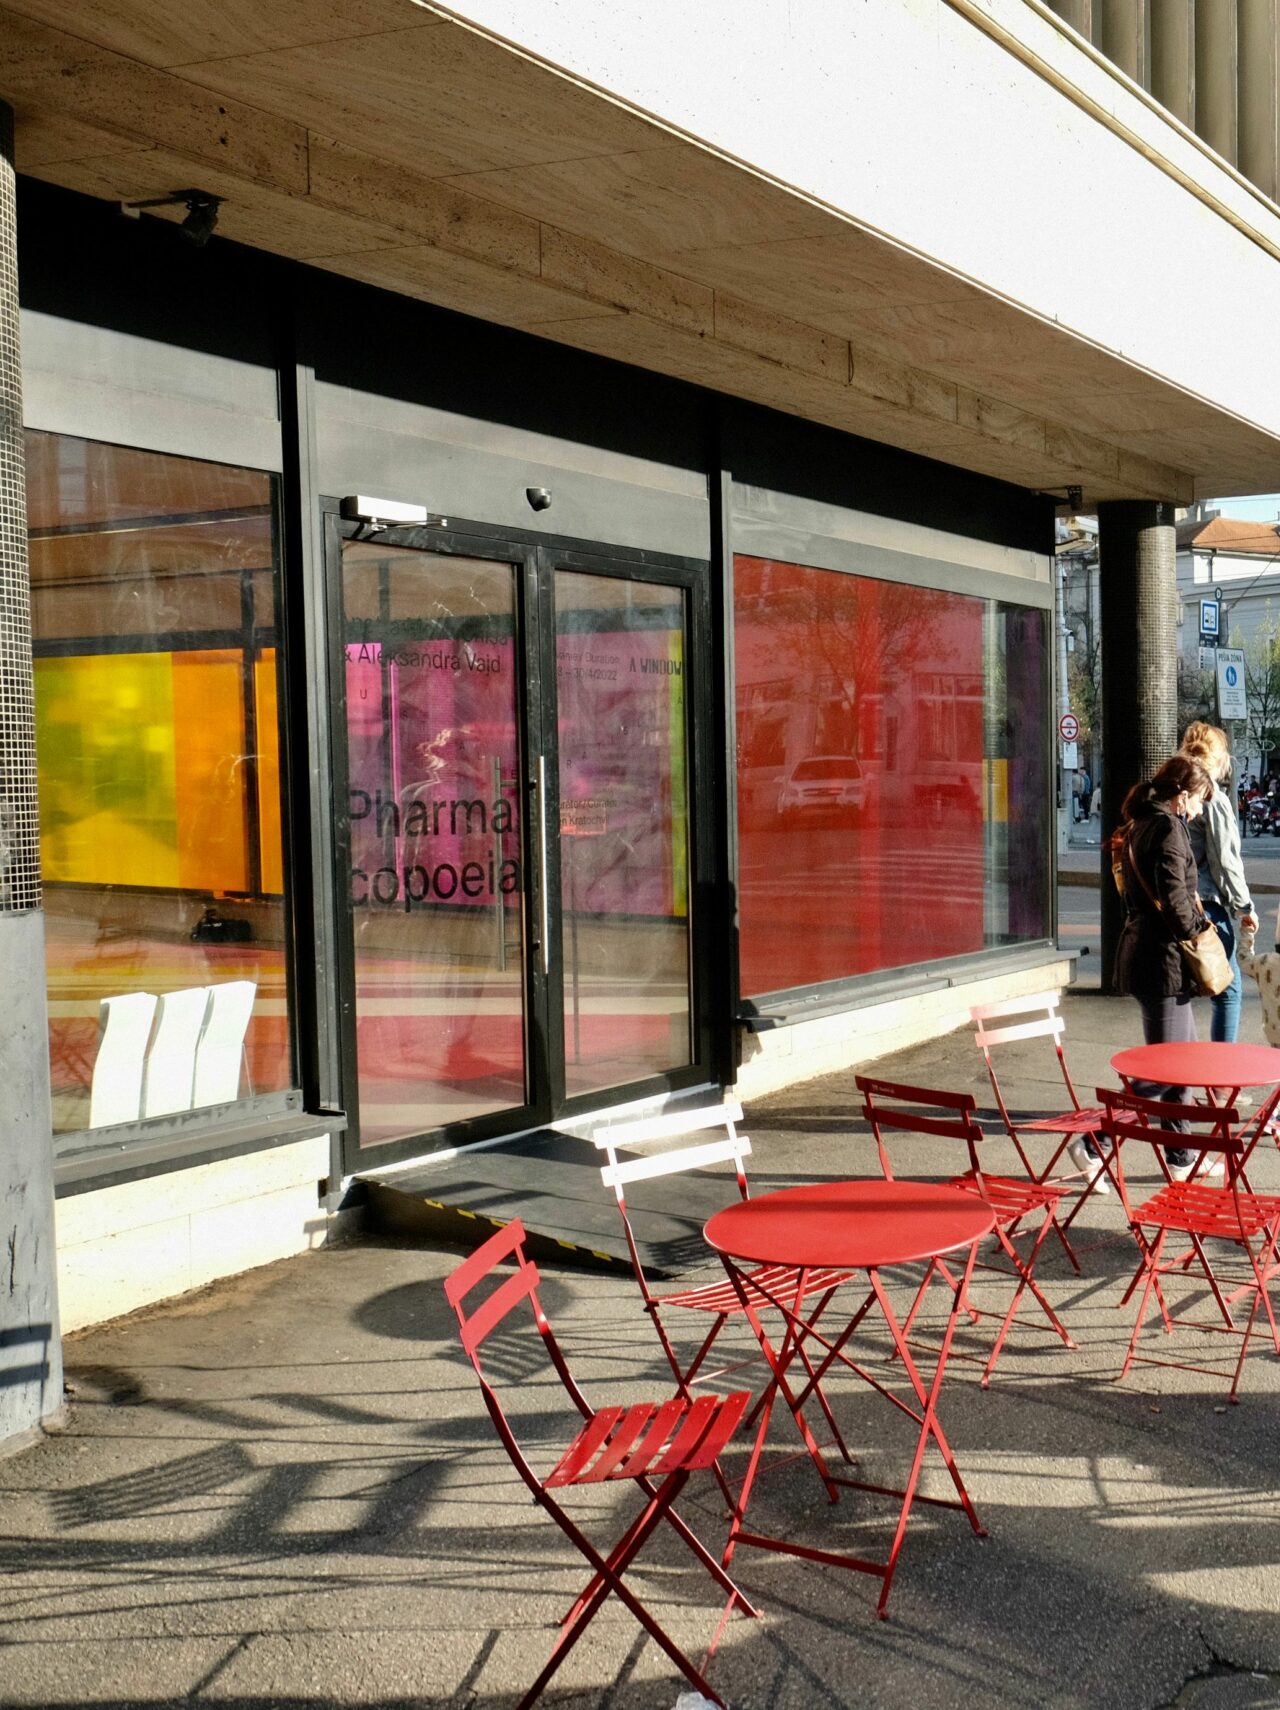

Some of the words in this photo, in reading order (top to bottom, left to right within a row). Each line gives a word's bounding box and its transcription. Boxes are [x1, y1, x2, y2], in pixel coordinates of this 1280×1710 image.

[358, 644, 460, 670] Aleksandra
[465, 651, 501, 676] Vajd
[640, 658, 682, 676] WINDOW
[349, 788, 513, 838] Pharma
[350, 850, 522, 913] copoeia
